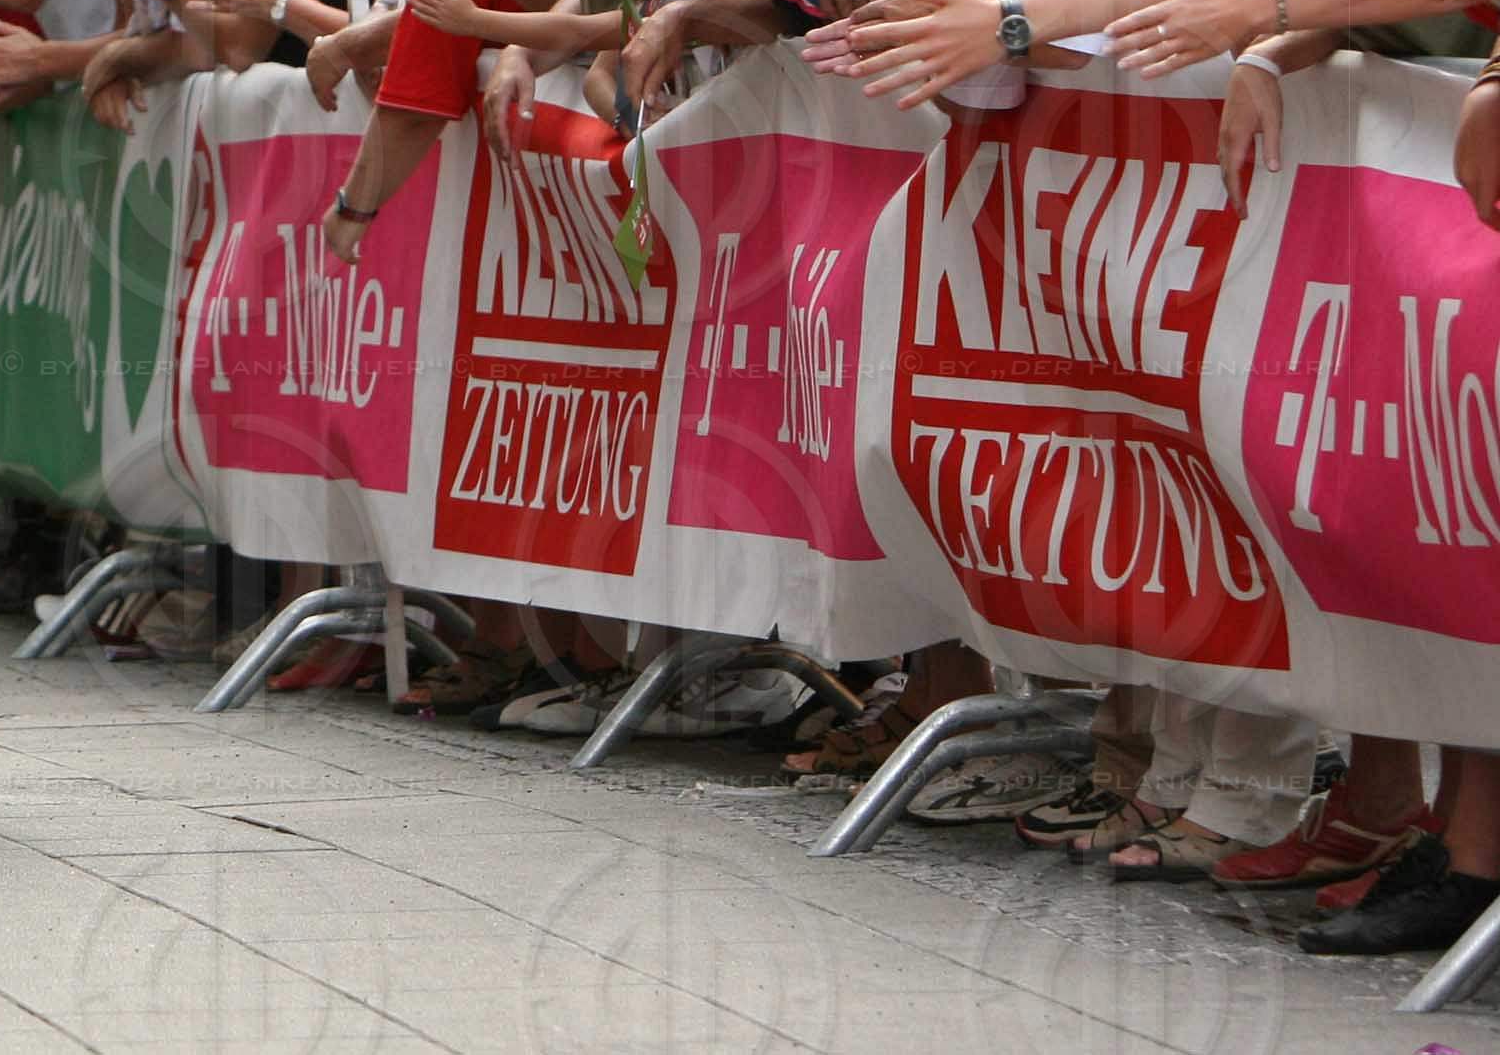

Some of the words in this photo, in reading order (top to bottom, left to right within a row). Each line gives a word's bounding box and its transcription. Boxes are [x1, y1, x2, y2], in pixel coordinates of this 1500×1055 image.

[913, 140, 1229, 379] KLEINE
[449, 375, 650, 522] ZEITUNG
[910, 424, 1267, 602] ZEITUNG
